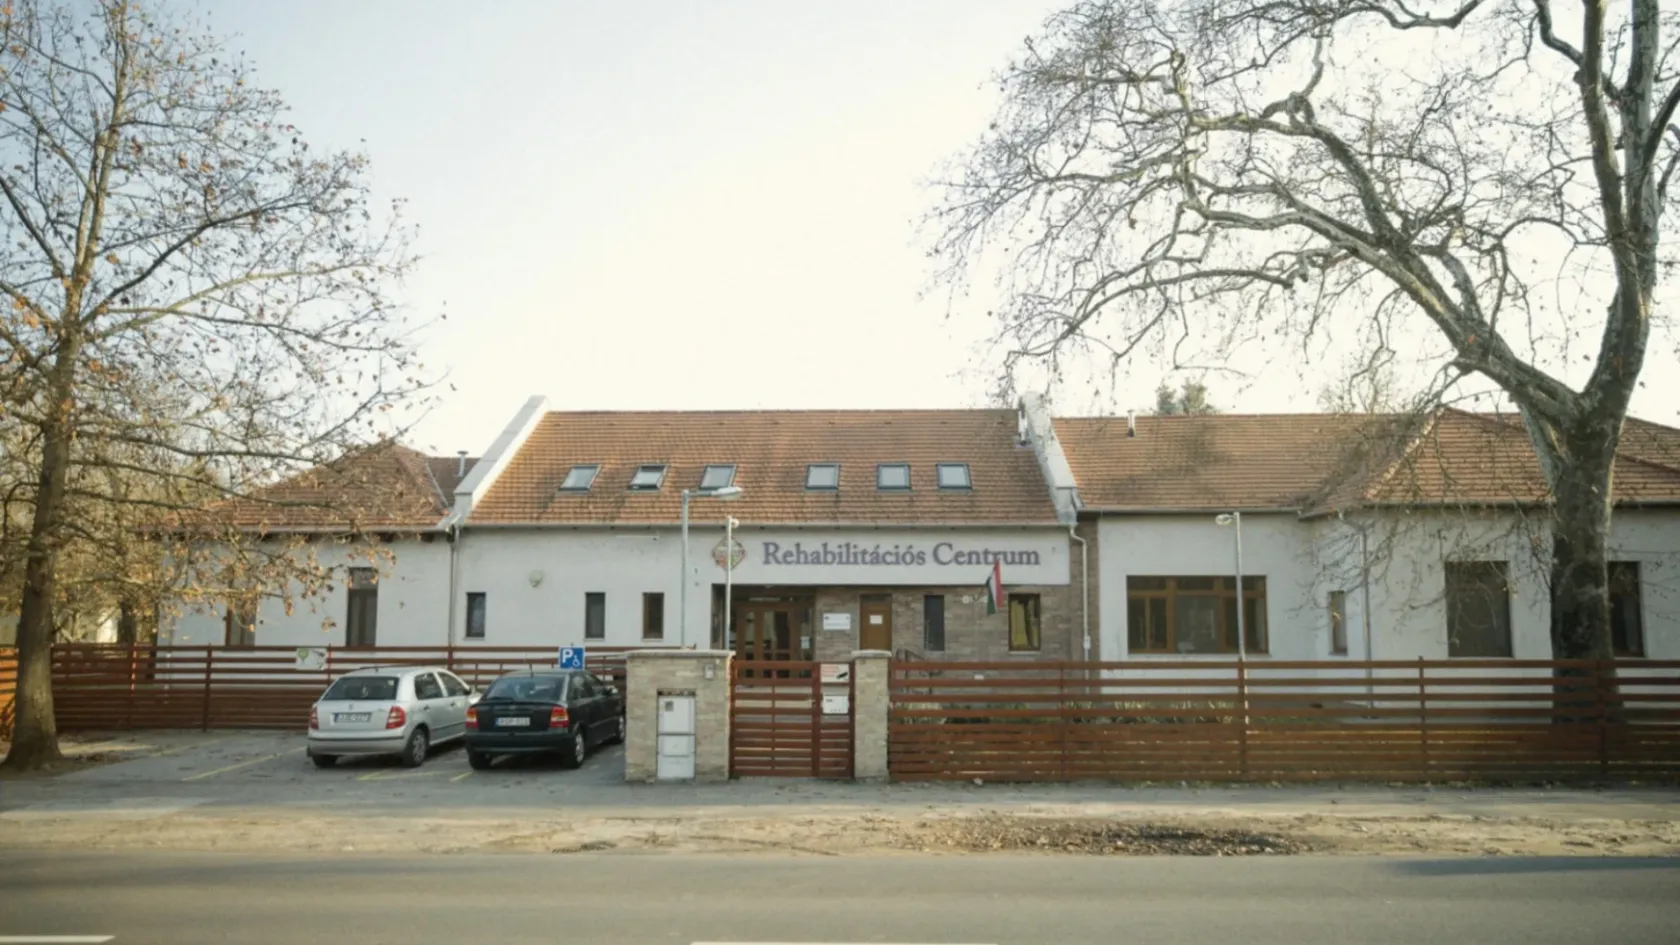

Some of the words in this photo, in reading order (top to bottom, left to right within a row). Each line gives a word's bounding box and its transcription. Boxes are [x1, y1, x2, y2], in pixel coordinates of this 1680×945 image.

[763, 541, 926, 565] Rehabilitációs
[933, 542, 1040, 566] Centrum
[562, 649, 573, 663] P
